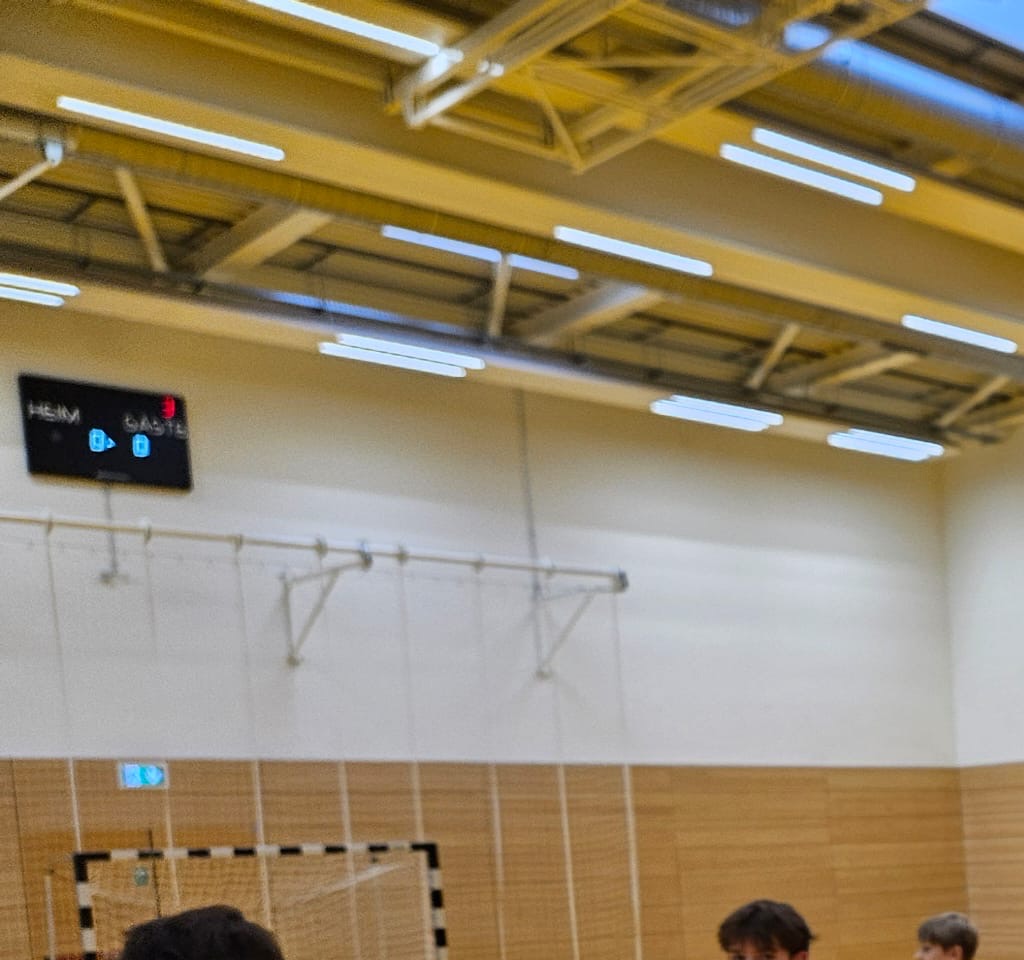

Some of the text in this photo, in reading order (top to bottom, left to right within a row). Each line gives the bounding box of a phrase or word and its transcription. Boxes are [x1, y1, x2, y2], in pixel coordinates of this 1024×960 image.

[27, 400, 80, 424] HEIM
[89, 428, 105, 452] 0
[132, 433, 150, 457] 0
